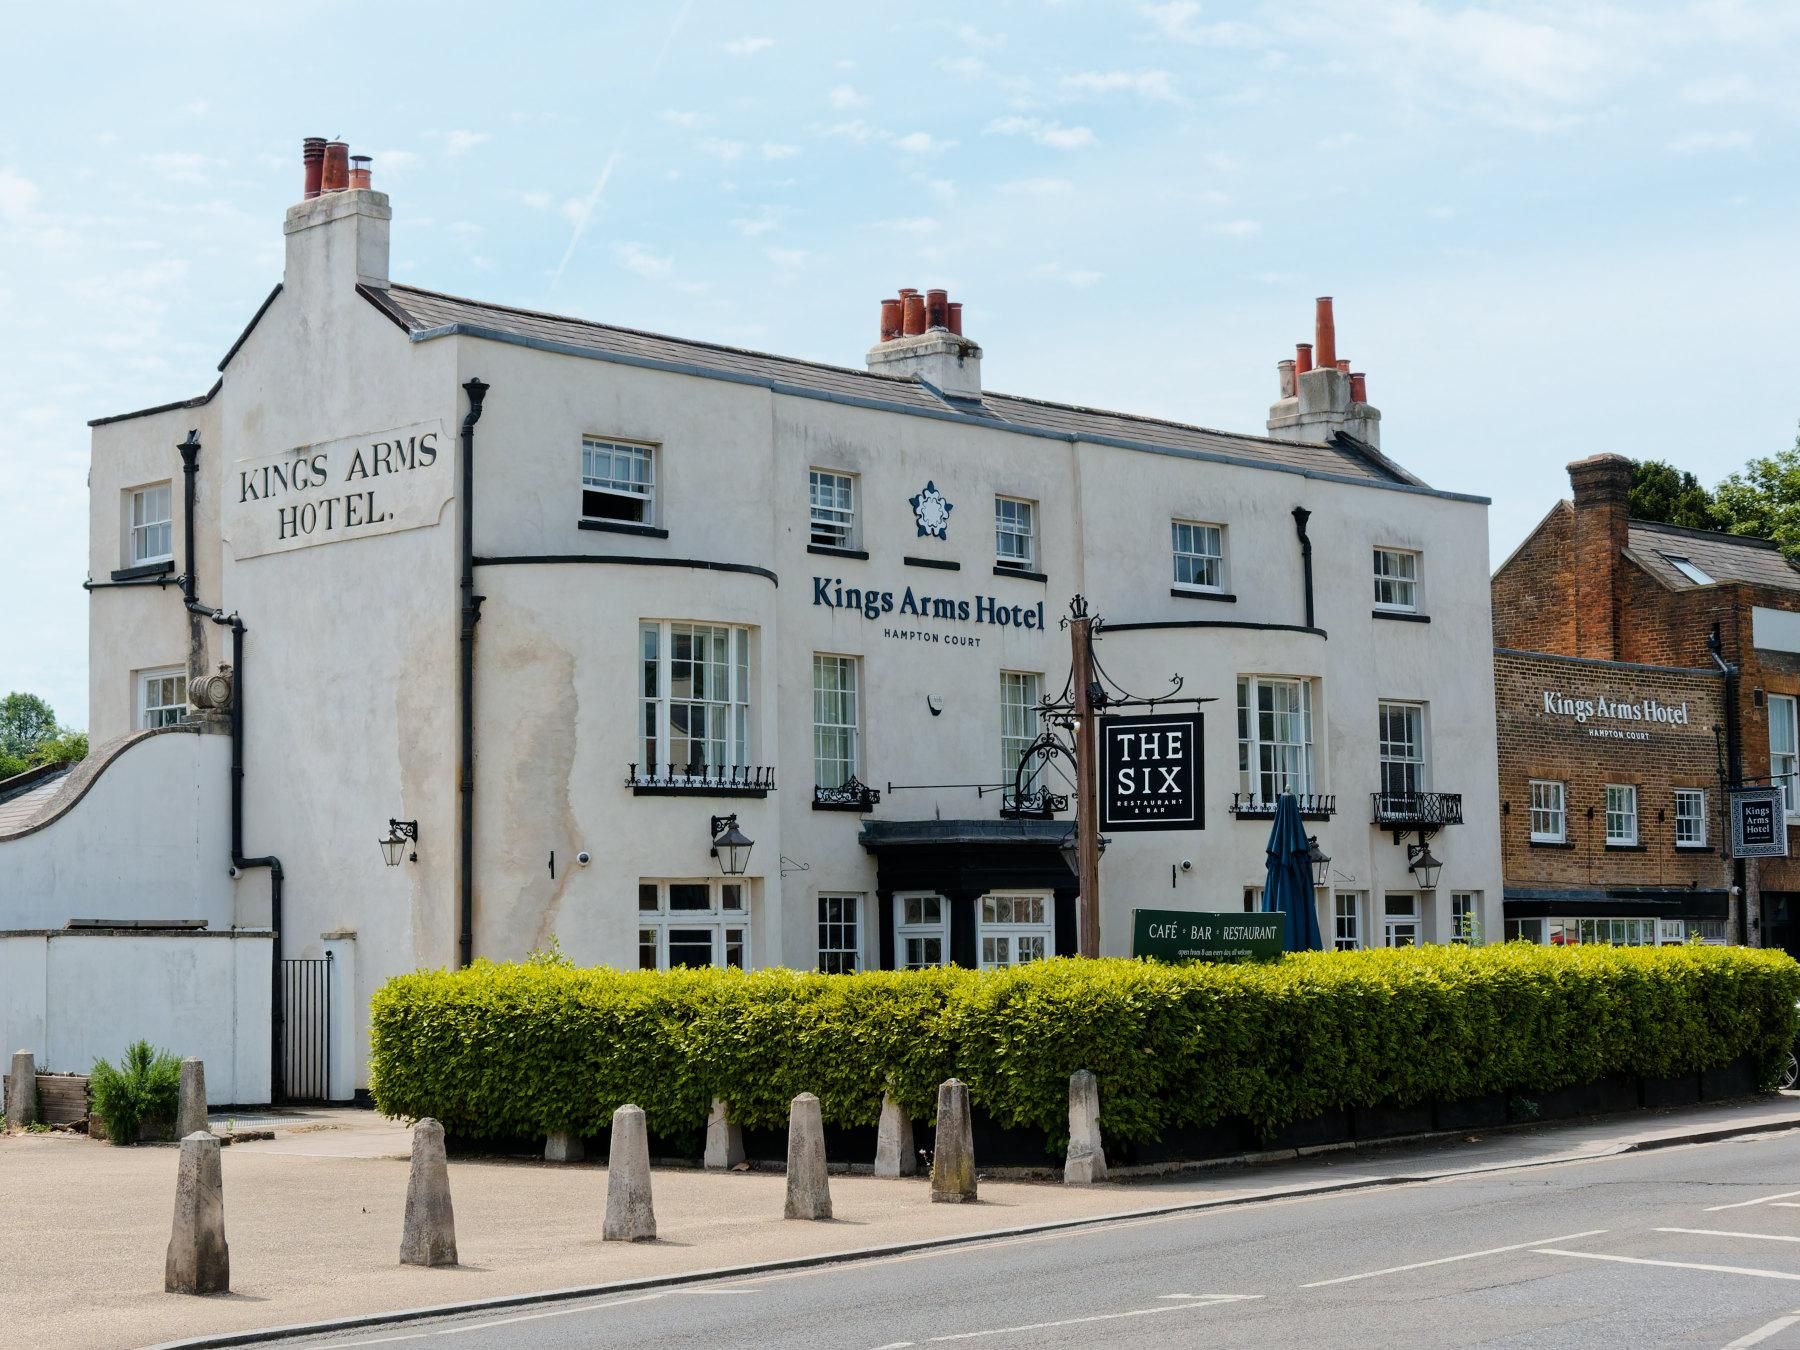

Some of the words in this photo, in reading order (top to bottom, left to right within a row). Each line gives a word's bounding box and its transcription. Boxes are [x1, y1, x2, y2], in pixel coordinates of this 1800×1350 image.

[239, 453, 328, 503] KINGS
[345, 432, 438, 482] ARMS
[812, 576, 894, 620] Kings
[899, 586, 971, 621] Arms
[974, 595, 1045, 630] Hotel
[884, 628, 939, 643] HAMPTON
[944, 635, 981, 648] COURT
[1543, 691, 1594, 723] Kings
[1597, 695, 1642, 721] Arms
[1643, 700, 1689, 725] Hotel
[1588, 728, 1624, 739] HAMPTON
[1626, 732, 1650, 741] COURT
[1117, 731, 1183, 761] THE
[1117, 766, 1182, 795] SIX
[1117, 799, 1183, 807] RESTAURANT
[1745, 806, 1770, 816] Kings
[1746, 817, 1769, 825] Arms
[1746, 825, 1770, 834] Hotel
[1149, 921, 1178, 939] CAFÉ
[1190, 925, 1212, 940] BAR
[1223, 926, 1277, 940] RESTAURANT
